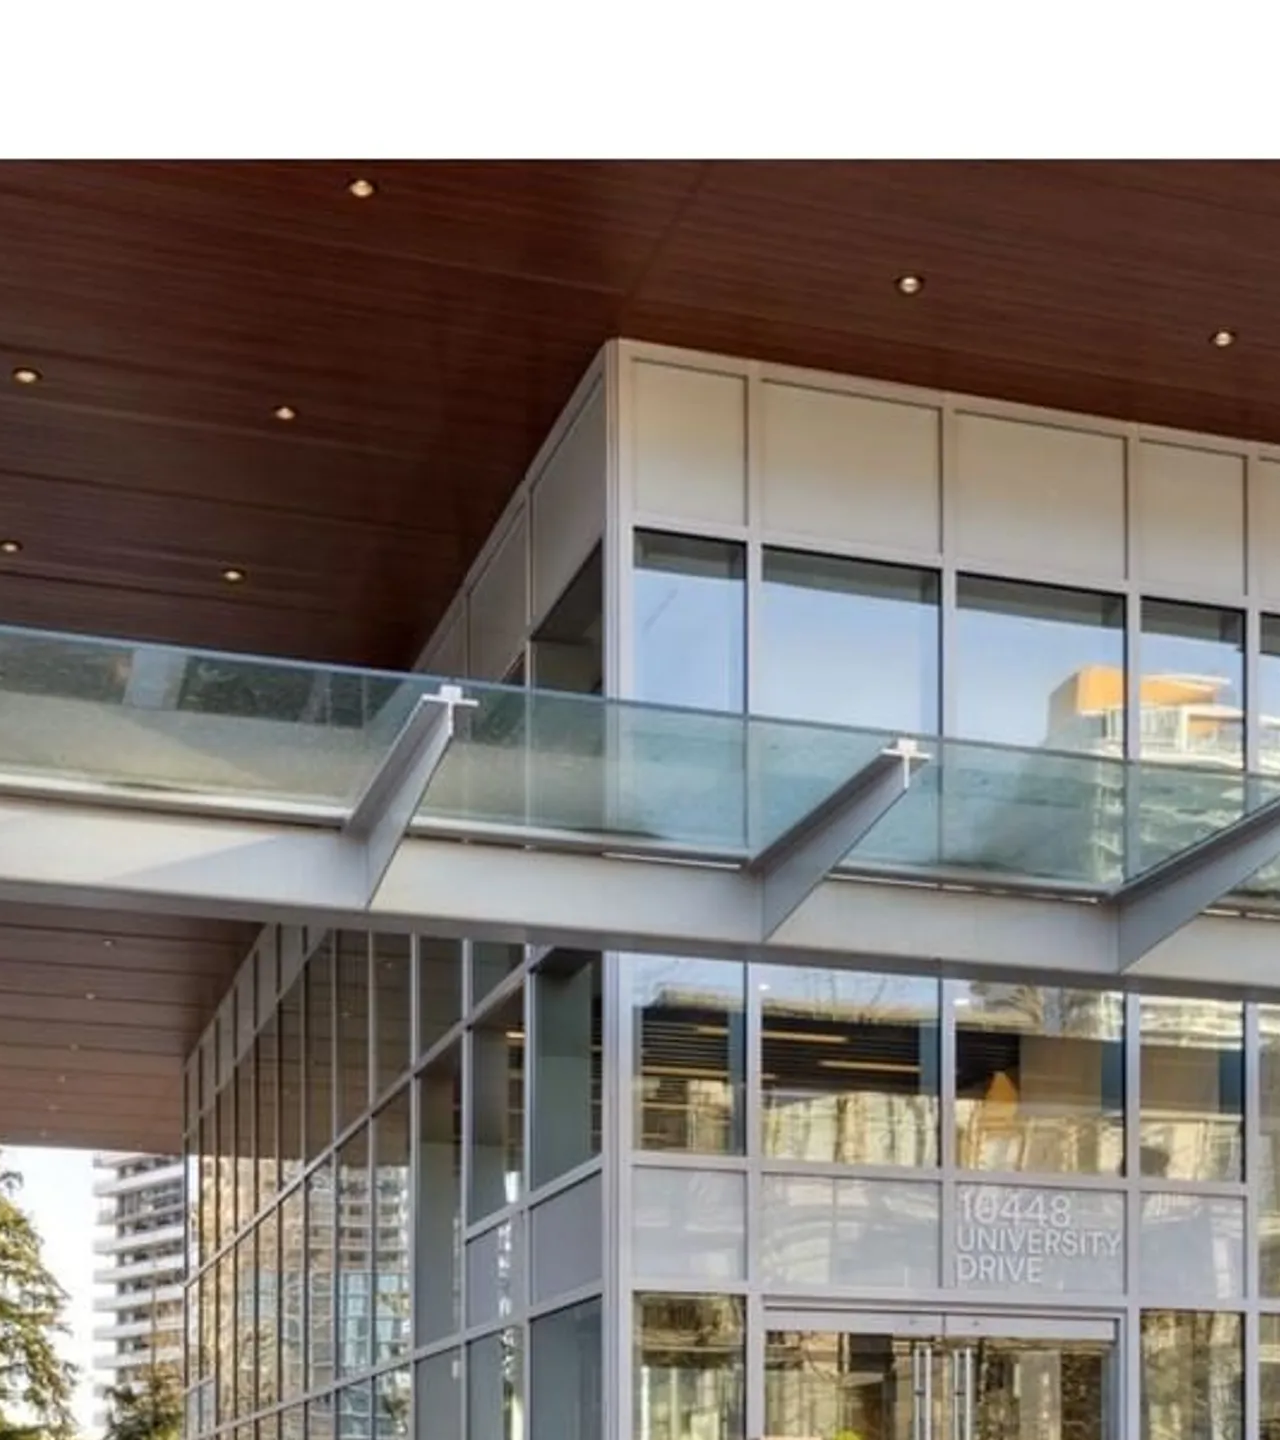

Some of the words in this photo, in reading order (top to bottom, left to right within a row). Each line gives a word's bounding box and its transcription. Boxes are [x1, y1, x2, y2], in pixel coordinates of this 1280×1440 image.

[960, 1189, 1072, 1228] 10448
[956, 1227, 1122, 1257] UNIVERSITY
[956, 1254, 1044, 1284] DRIVE
